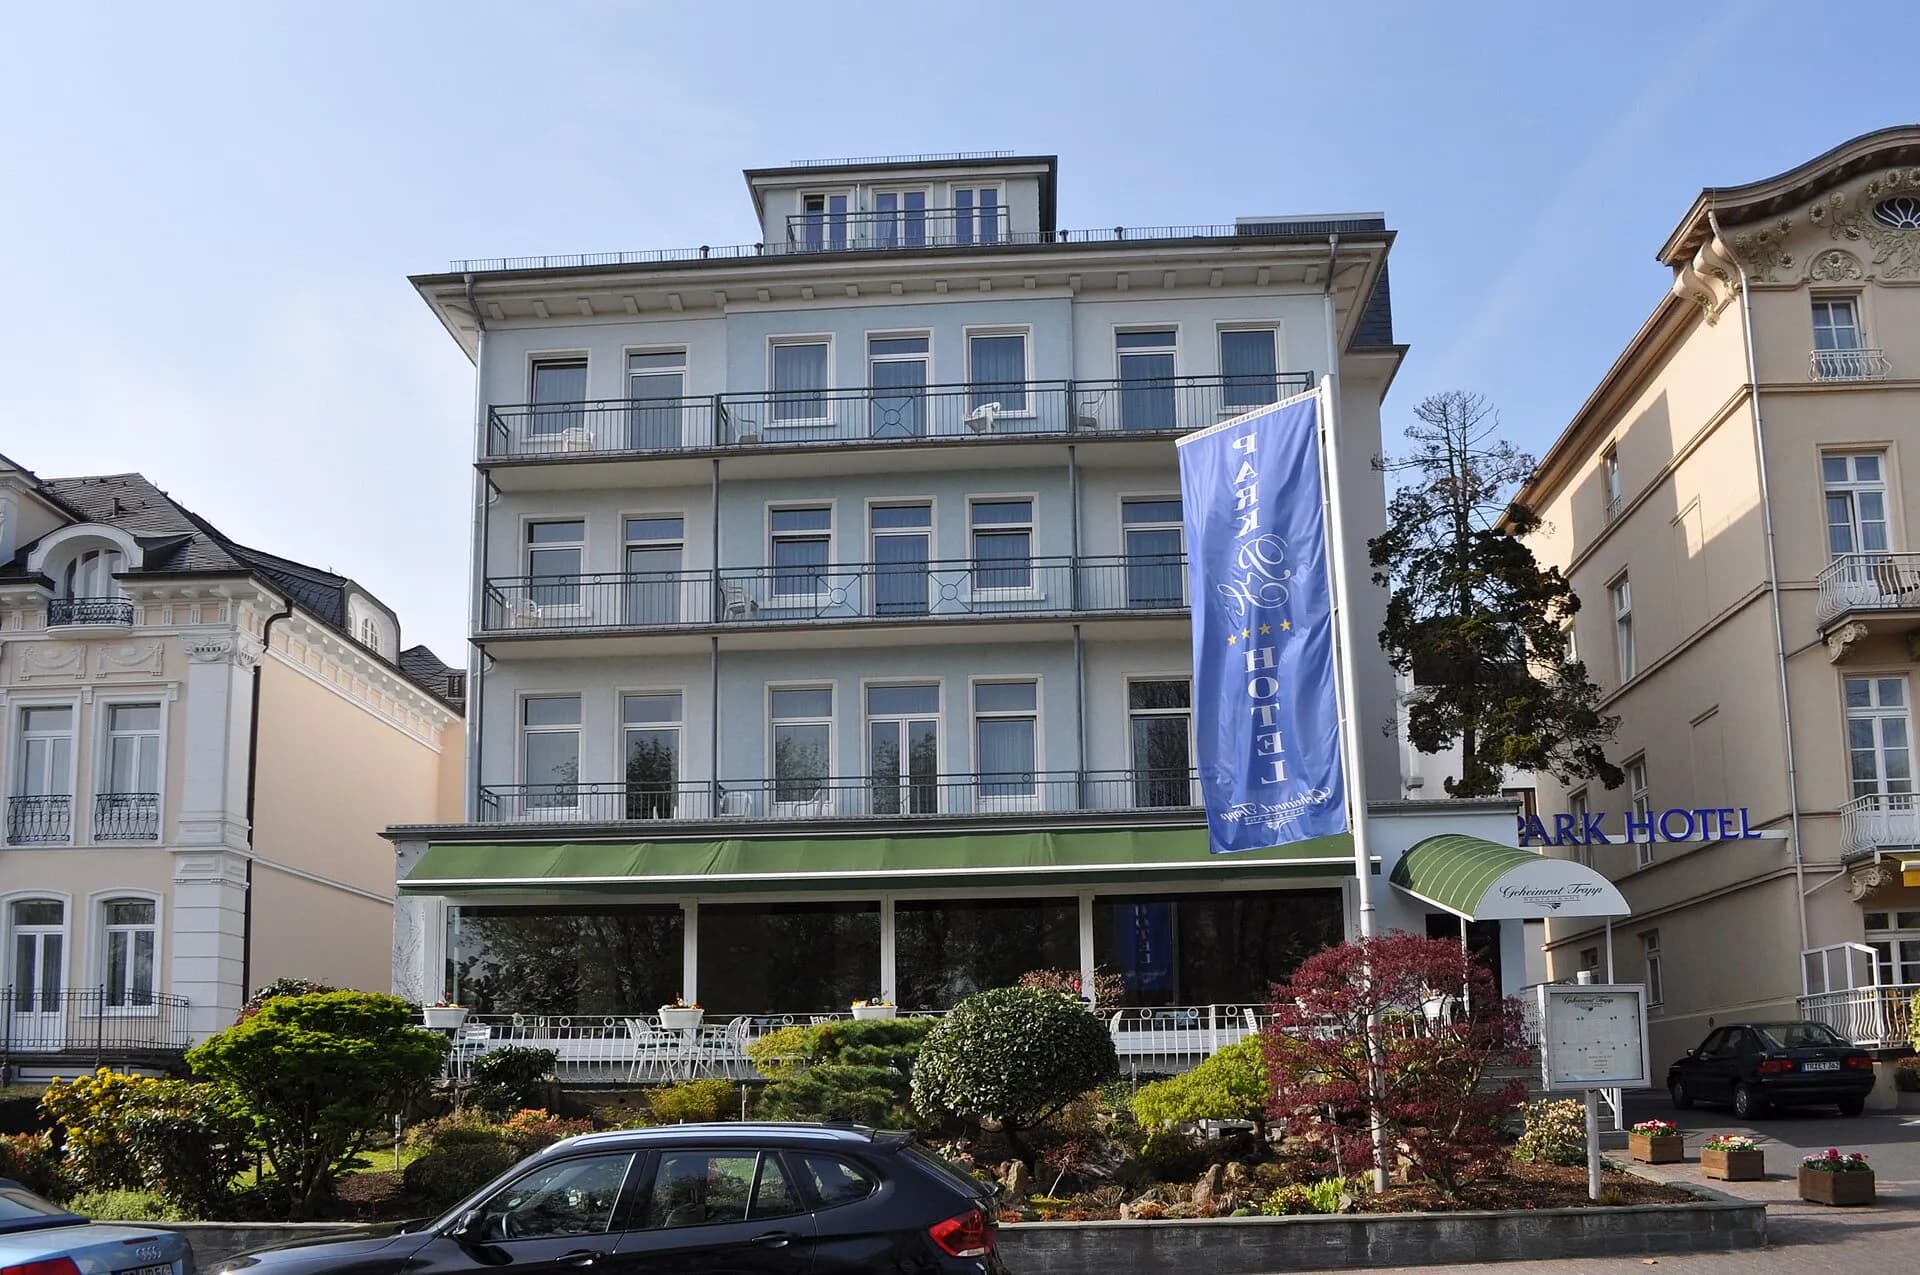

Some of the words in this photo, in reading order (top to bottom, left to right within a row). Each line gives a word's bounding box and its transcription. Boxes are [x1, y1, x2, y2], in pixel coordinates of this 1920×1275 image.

[1624, 807, 1761, 844] HOTEL
[1500, 885, 1563, 898] Geheimrat
[1567, 883, 1602, 896] Trapp
